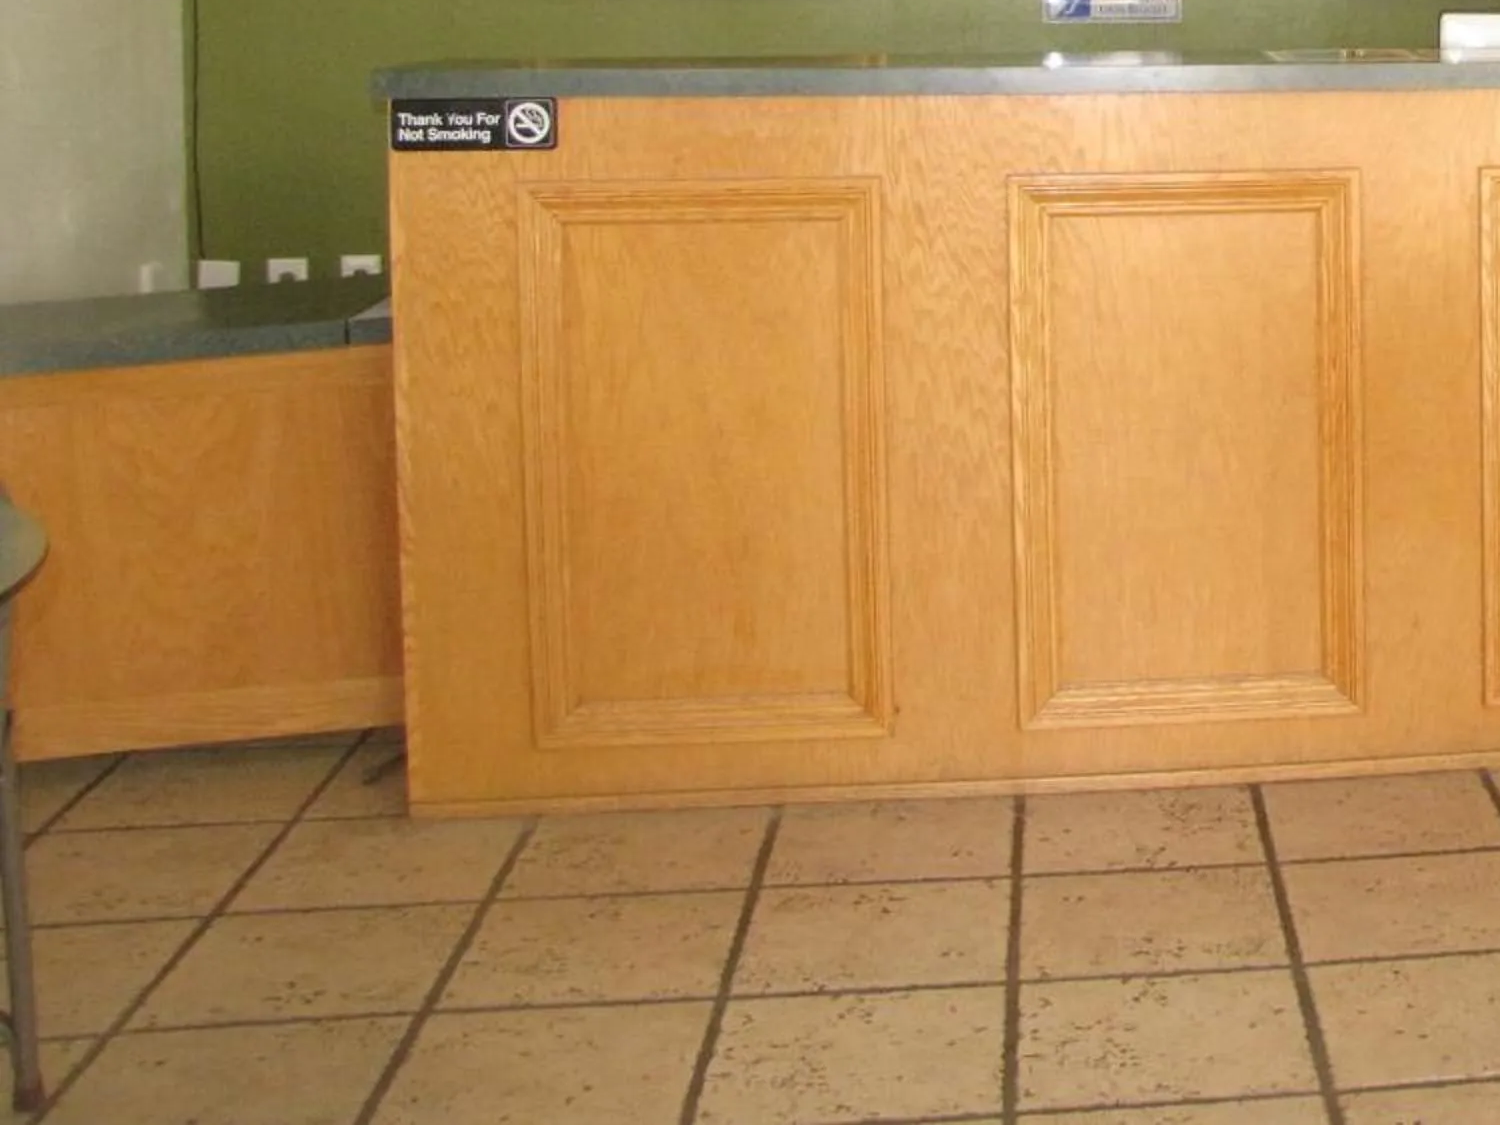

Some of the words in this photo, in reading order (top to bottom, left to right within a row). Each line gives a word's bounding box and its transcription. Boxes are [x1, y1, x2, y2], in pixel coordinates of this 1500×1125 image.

[397, 112, 443, 127] Thank
[447, 113, 473, 127] You
[476, 112, 501, 126] For
[398, 127, 424, 142] Not
[427, 128, 492, 144] Smoking
